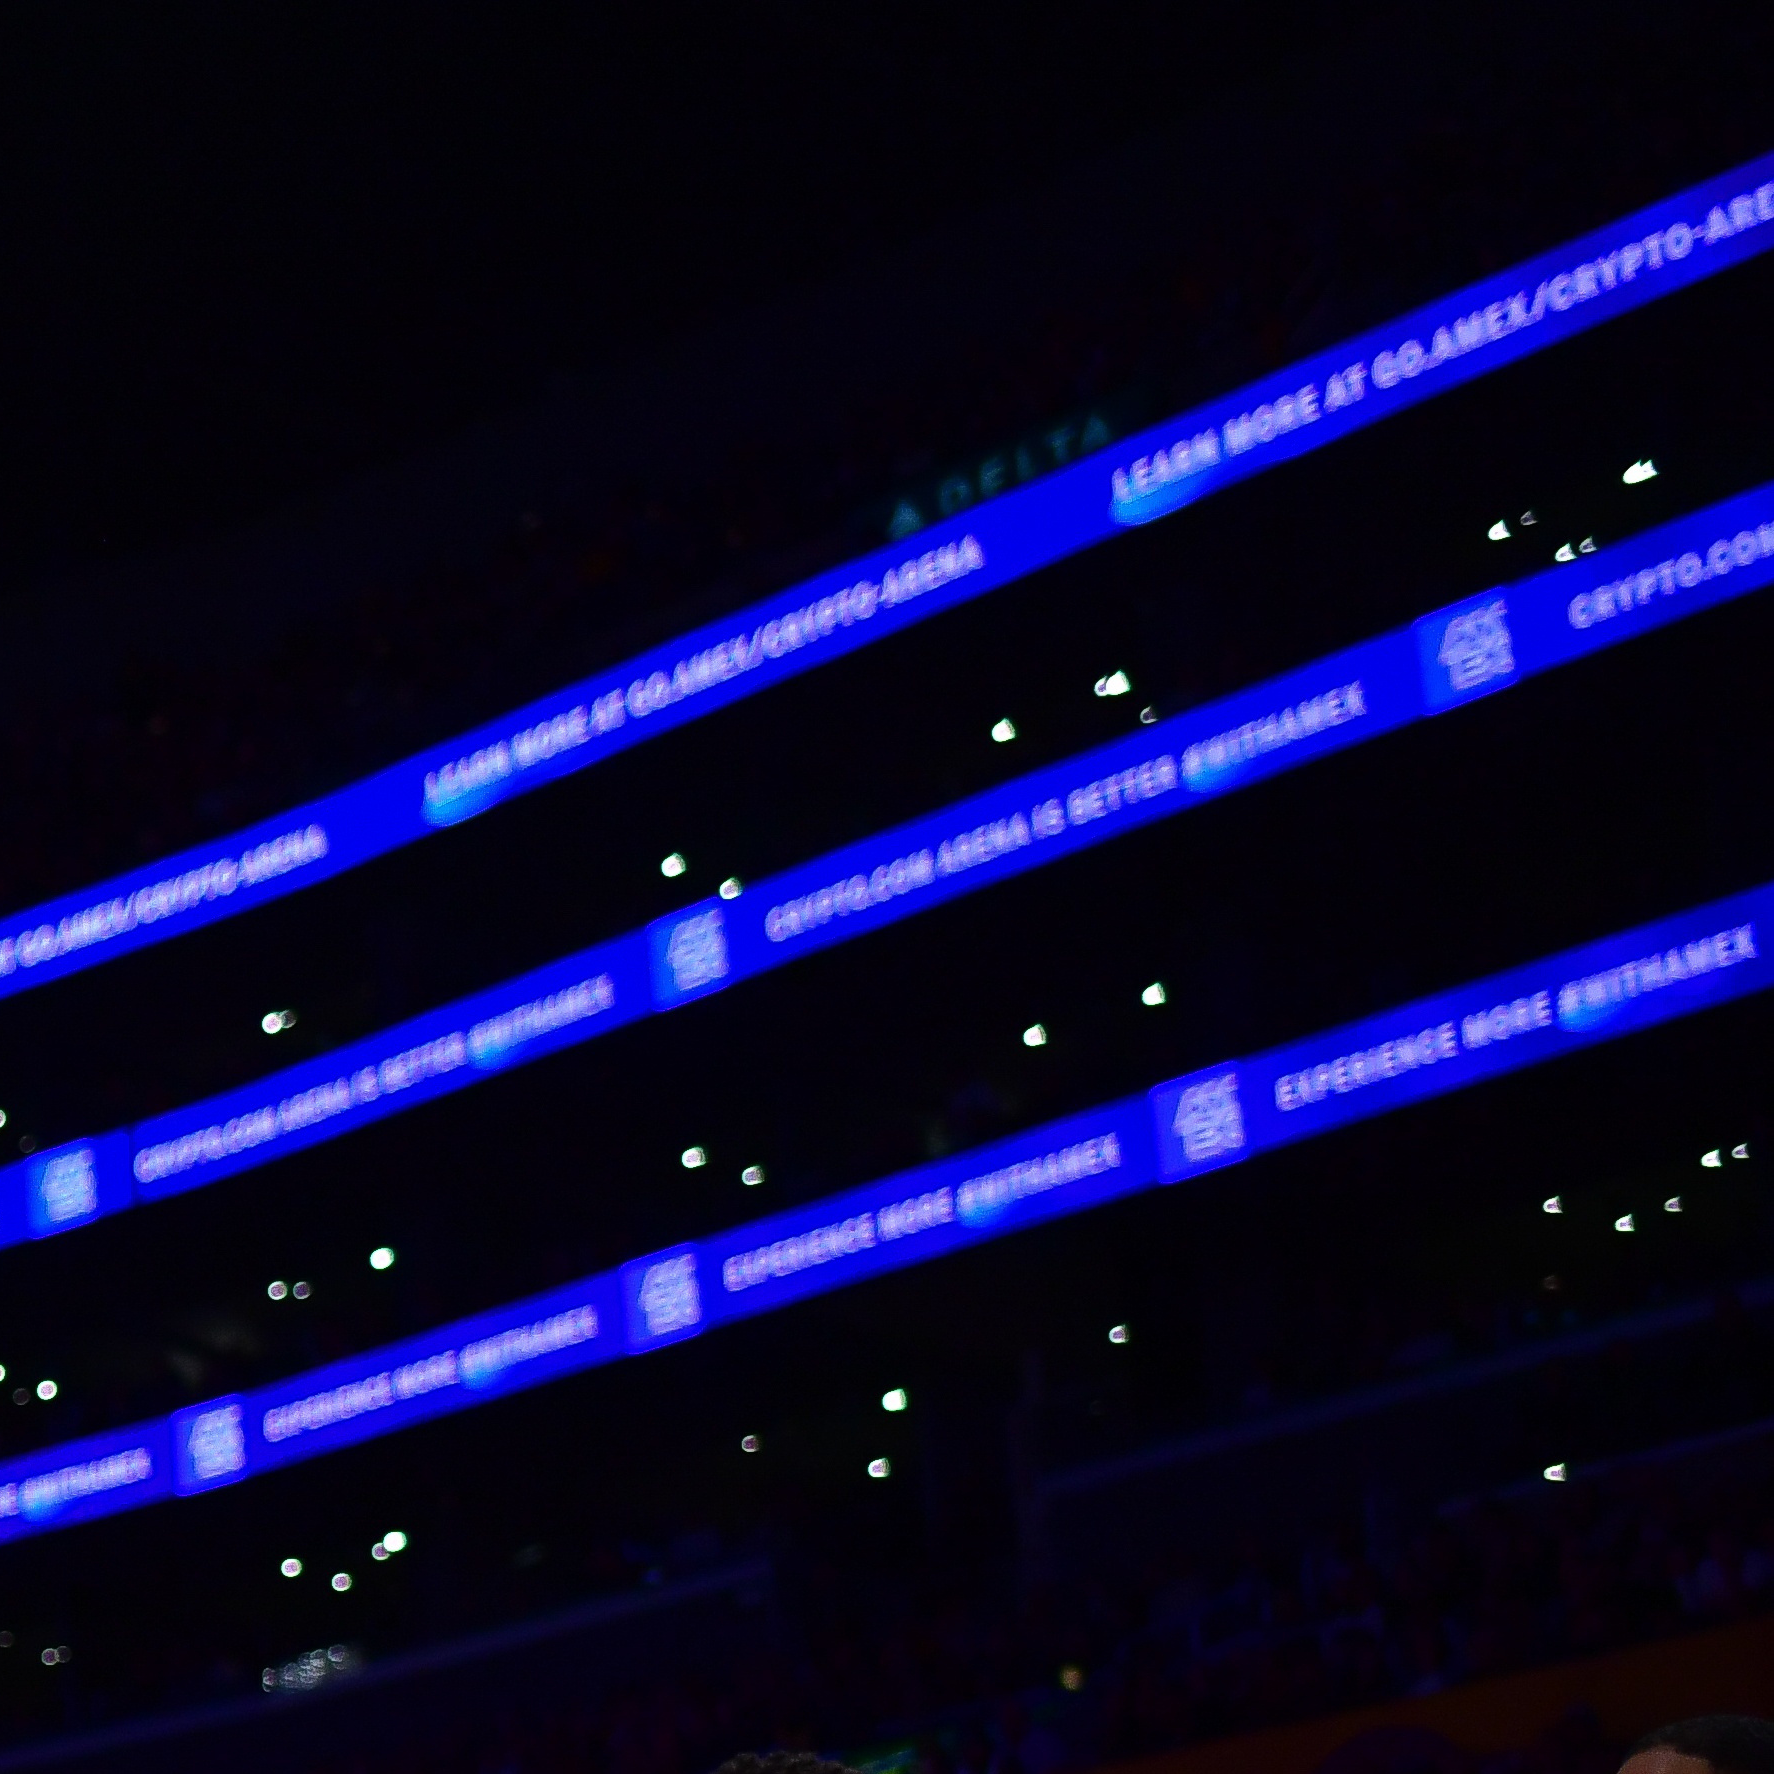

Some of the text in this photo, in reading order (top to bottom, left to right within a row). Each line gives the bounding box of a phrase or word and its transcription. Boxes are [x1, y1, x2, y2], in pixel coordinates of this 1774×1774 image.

[1113, 430, 1219, 502] LEARN
[1224, 385, 1320, 454] MORE
[1325, 363, 1366, 411] AT
[425, 743, 514, 803] LEARN
[512, 707, 590, 766] MORE
[592, 690, 626, 734] AT
[936, 815, 1029, 873] ARENA
[1032, 799, 1065, 837] IS
[1068, 756, 1176, 824] BETTER
[1276, 1023, 1457, 1110] EXPERIENCE
[1463, 992, 1551, 1047] MORE
[878, 1188, 953, 1239] MORE
